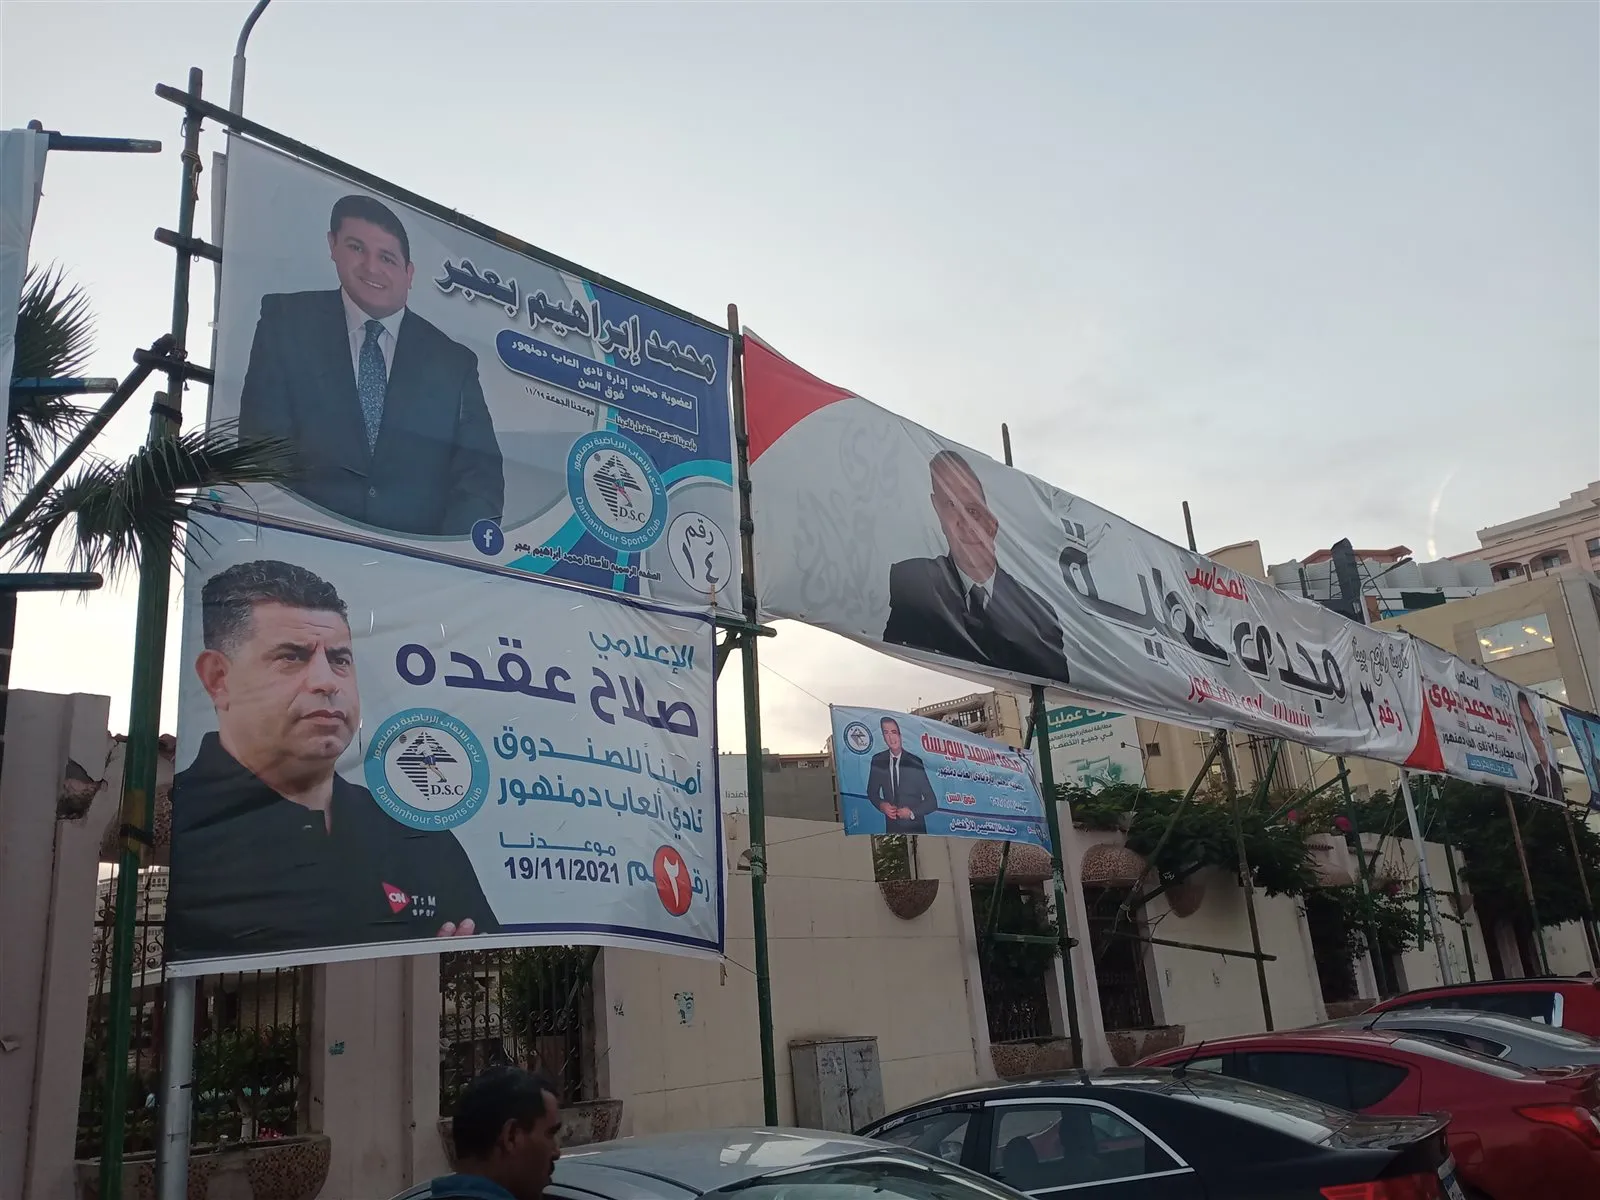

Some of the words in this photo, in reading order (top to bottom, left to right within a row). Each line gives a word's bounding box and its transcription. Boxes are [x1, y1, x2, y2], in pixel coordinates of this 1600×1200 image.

[433, 258, 520, 317] بعجر
[527, 290, 641, 366] إبراهيم
[512, 341, 548, 357] دمنهور
[551, 352, 579, 369] العاب
[645, 330, 717, 385] محمد
[578, 377, 600, 391] السن
[605, 386, 625, 401] فوق
[606, 372, 628, 390] إدارة
[631, 384, 658, 399] مجلس
[569, 401, 595, 416] موعدنا
[661, 391, 693, 410] لعضوية
[575, 497, 619, 542] Damanhour
[620, 534, 648, 547] Sports
[647, 519, 660, 537] Club
[619, 507, 646, 523] D.S.C
[685, 518, 715, 546] رقم
[514, 541, 532, 555] بعجر
[562, 552, 583, 565] محمد
[584, 555, 610, 570] للأستاذ
[682, 541, 719, 584] ١٤
[589, 631, 694, 674] الإعلامي
[396, 636, 576, 703] عقده
[590, 667, 699, 737] صلاح
[1464, 697, 1496, 722] محمد
[1047, 709, 1084, 727] عمليا
[1378, 698, 1403, 732] رقم
[1080, 735, 1099, 745] جميع
[1101, 731, 1114, 743] في
[493, 726, 642, 774] للصندوق
[430, 785, 464, 796] D.S.C
[498, 774, 602, 807] دمنهور
[962, 793, 976, 805] فوق
[376, 785, 431, 824] Damanhour
[434, 806, 468, 825] Sports
[465, 787, 482, 808] Club
[605, 788, 665, 820] ألعاب
[668, 807, 703, 839] نادي
[499, 831, 616, 856] موعدنا
[504, 856, 620, 884] 19/11/2021
